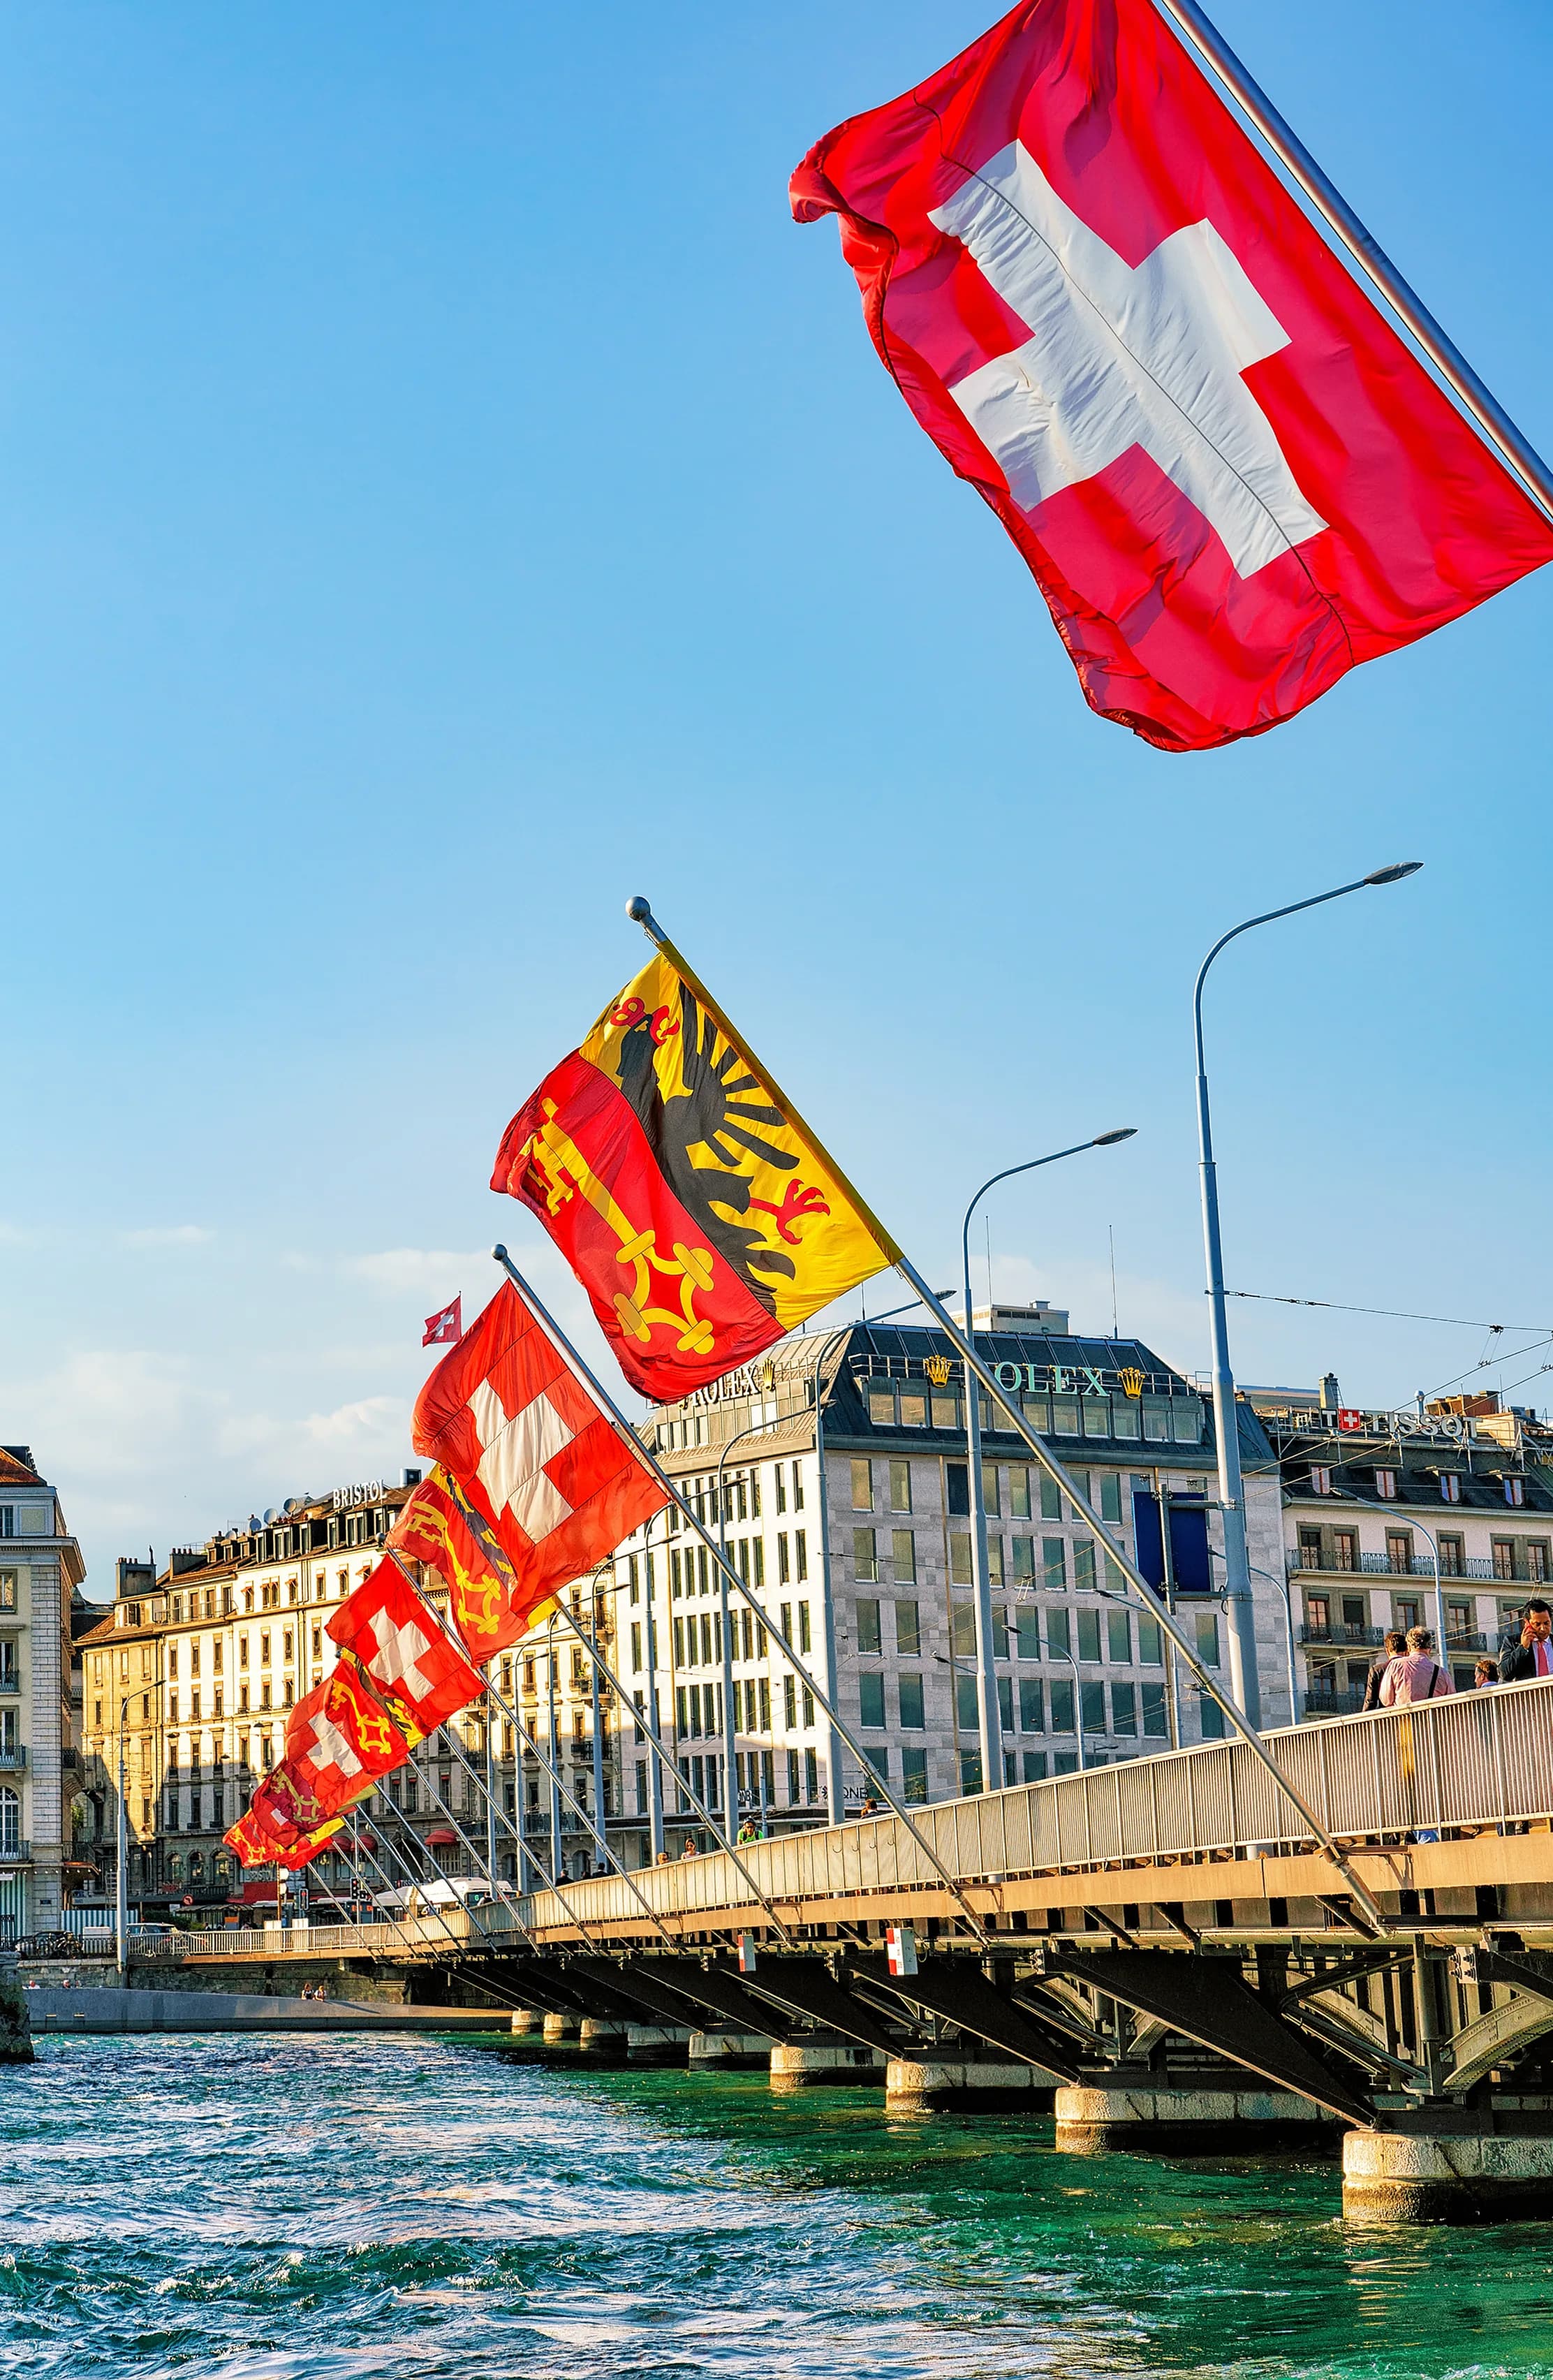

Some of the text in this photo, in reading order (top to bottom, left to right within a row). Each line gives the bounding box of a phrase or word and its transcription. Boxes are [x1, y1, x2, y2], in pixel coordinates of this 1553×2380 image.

[984, 1360, 1111, 1397] OLEX
[1365, 1410, 1483, 1438] TISSOT
[333, 1479, 388, 1509] BRISTOL
